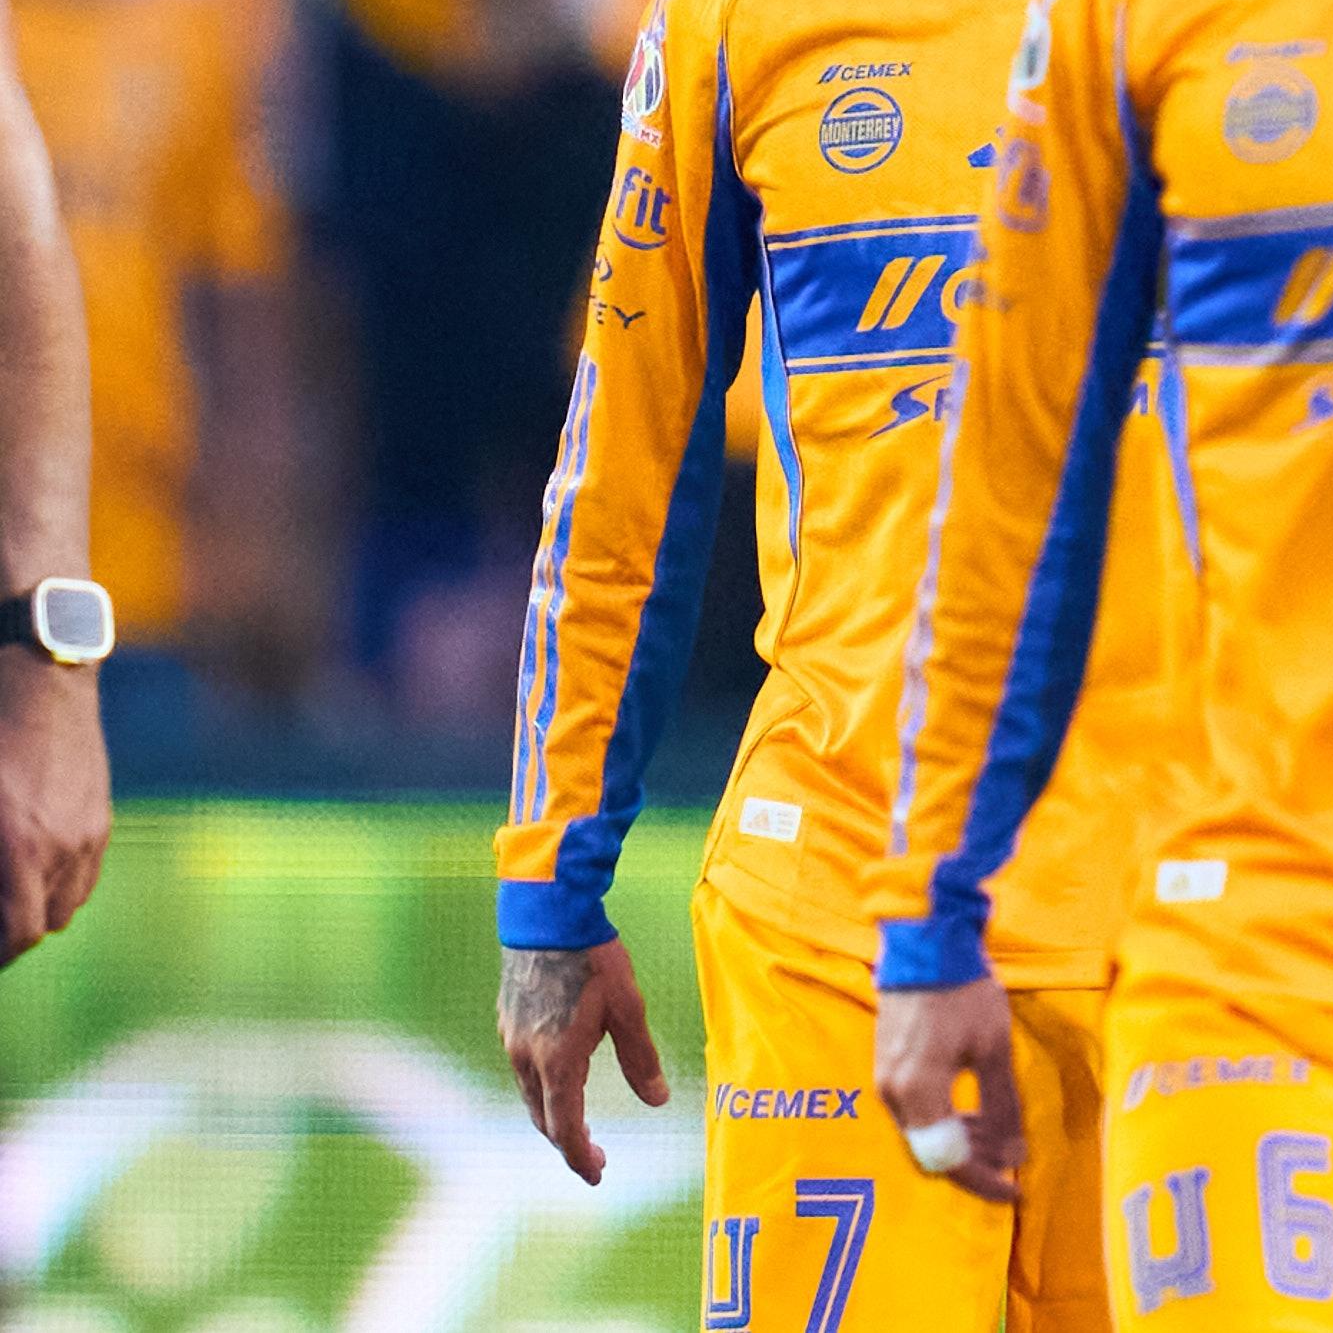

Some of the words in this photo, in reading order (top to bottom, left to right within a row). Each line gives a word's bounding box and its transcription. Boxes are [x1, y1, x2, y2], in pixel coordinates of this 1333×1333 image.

[840, 62, 912, 82] CEMEX
[821, 116, 902, 145] MONTERREY
[729, 1088, 861, 1119] CEMEX
[795, 1178, 875, 1333] 7
